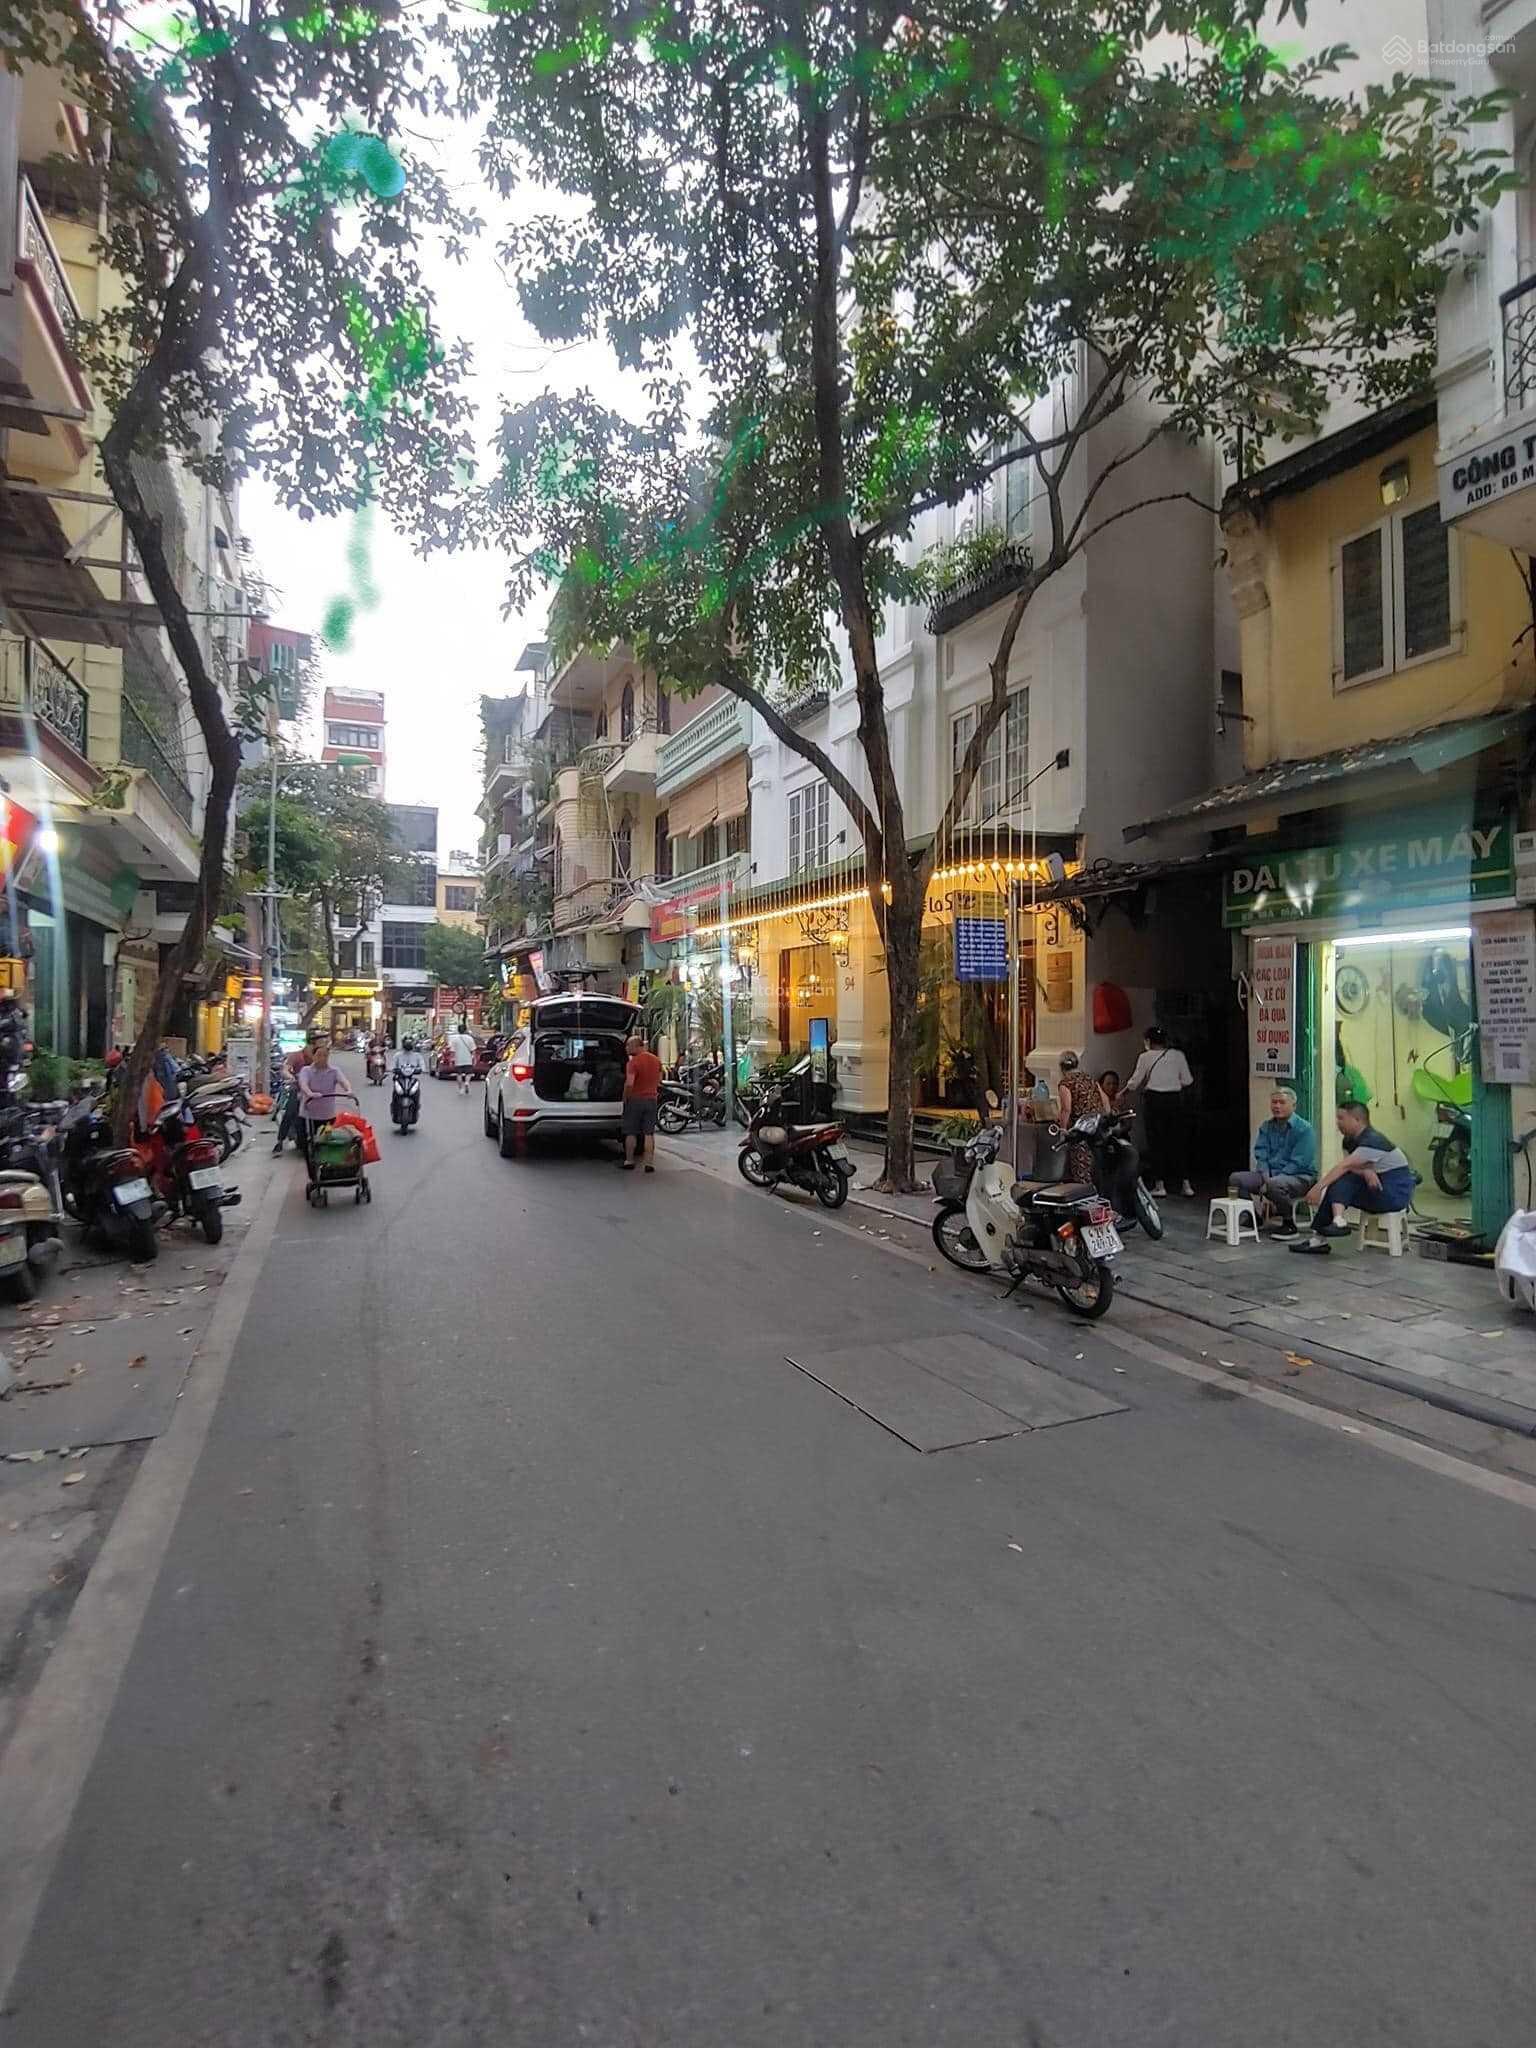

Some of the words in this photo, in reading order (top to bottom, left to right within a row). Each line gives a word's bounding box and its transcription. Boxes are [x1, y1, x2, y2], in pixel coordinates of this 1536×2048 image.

[1453, 446, 1516, 490] CÔNG
[1467, 483, 1497, 504] ADD:
[1350, 844, 1398, 879] XE
